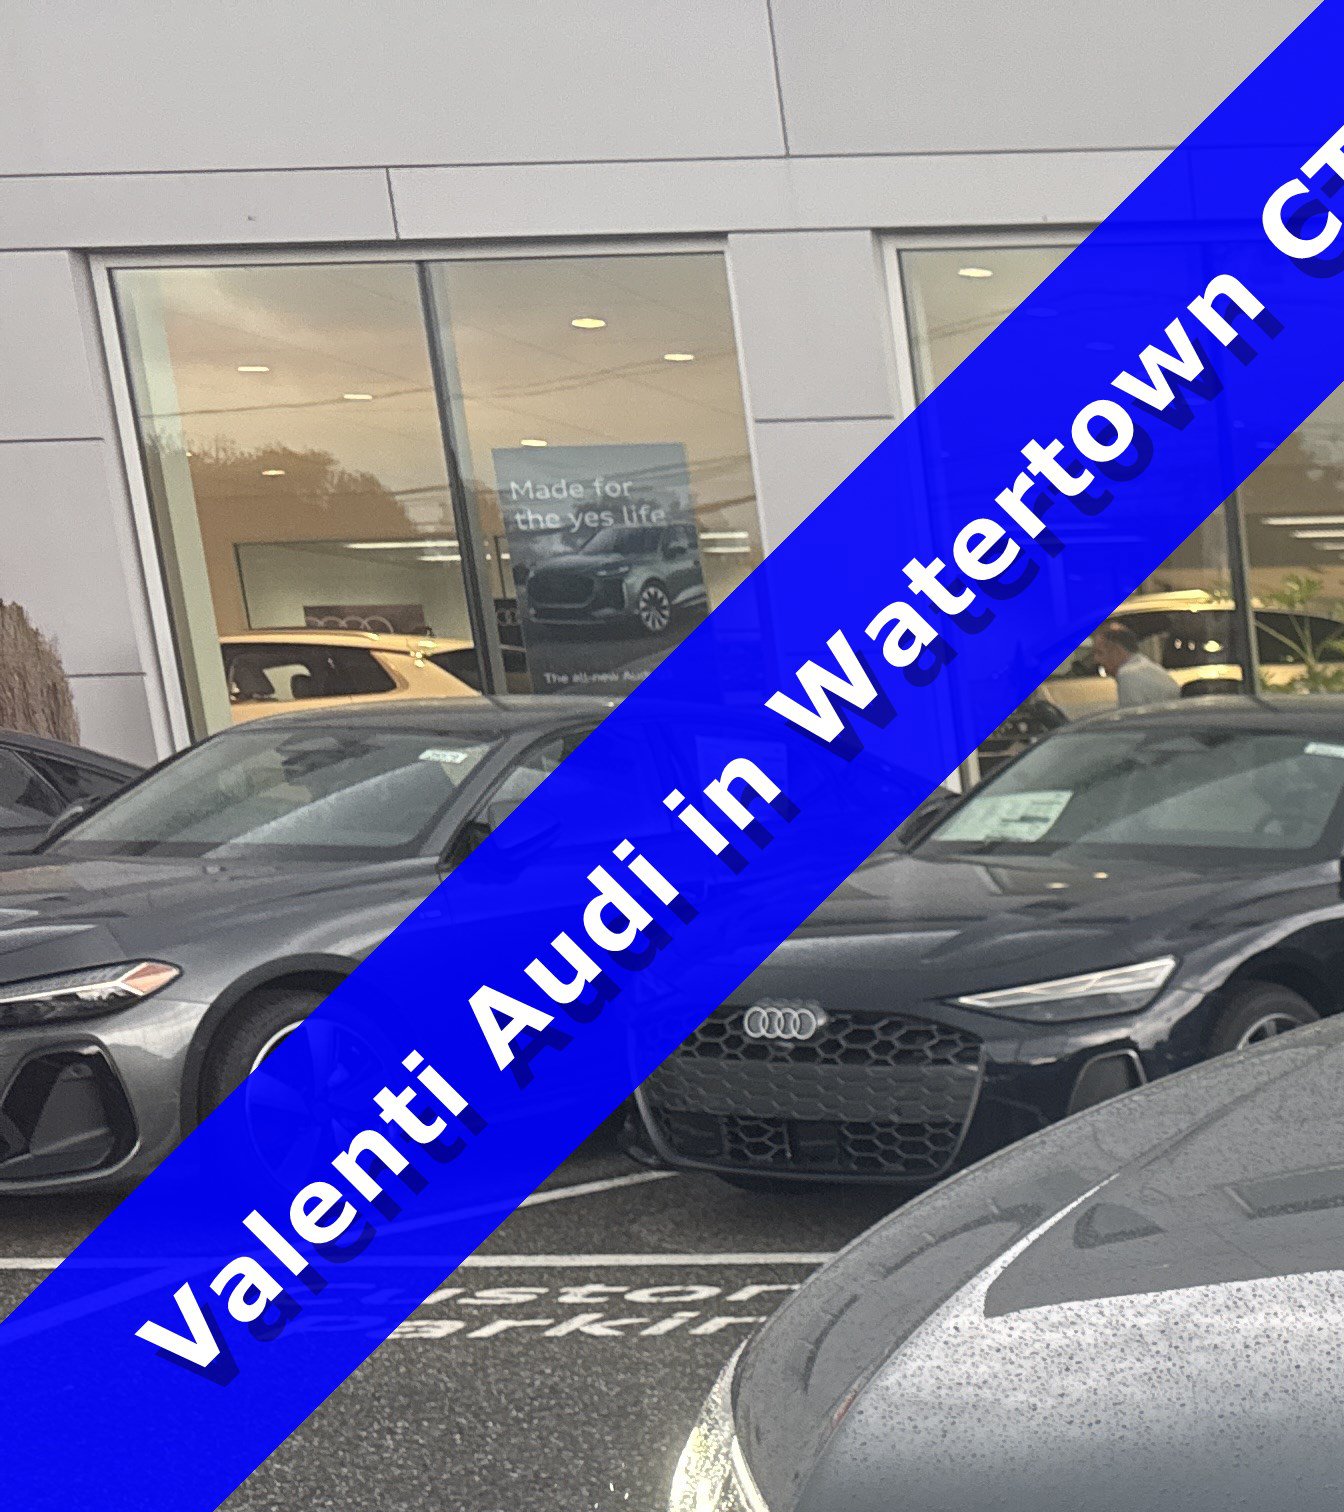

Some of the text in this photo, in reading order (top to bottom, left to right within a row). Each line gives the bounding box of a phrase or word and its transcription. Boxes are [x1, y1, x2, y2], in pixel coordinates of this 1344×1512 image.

[510, 476, 633, 500] Made for
[515, 504, 667, 533] the yes life
[543, 672, 569, 684] The
